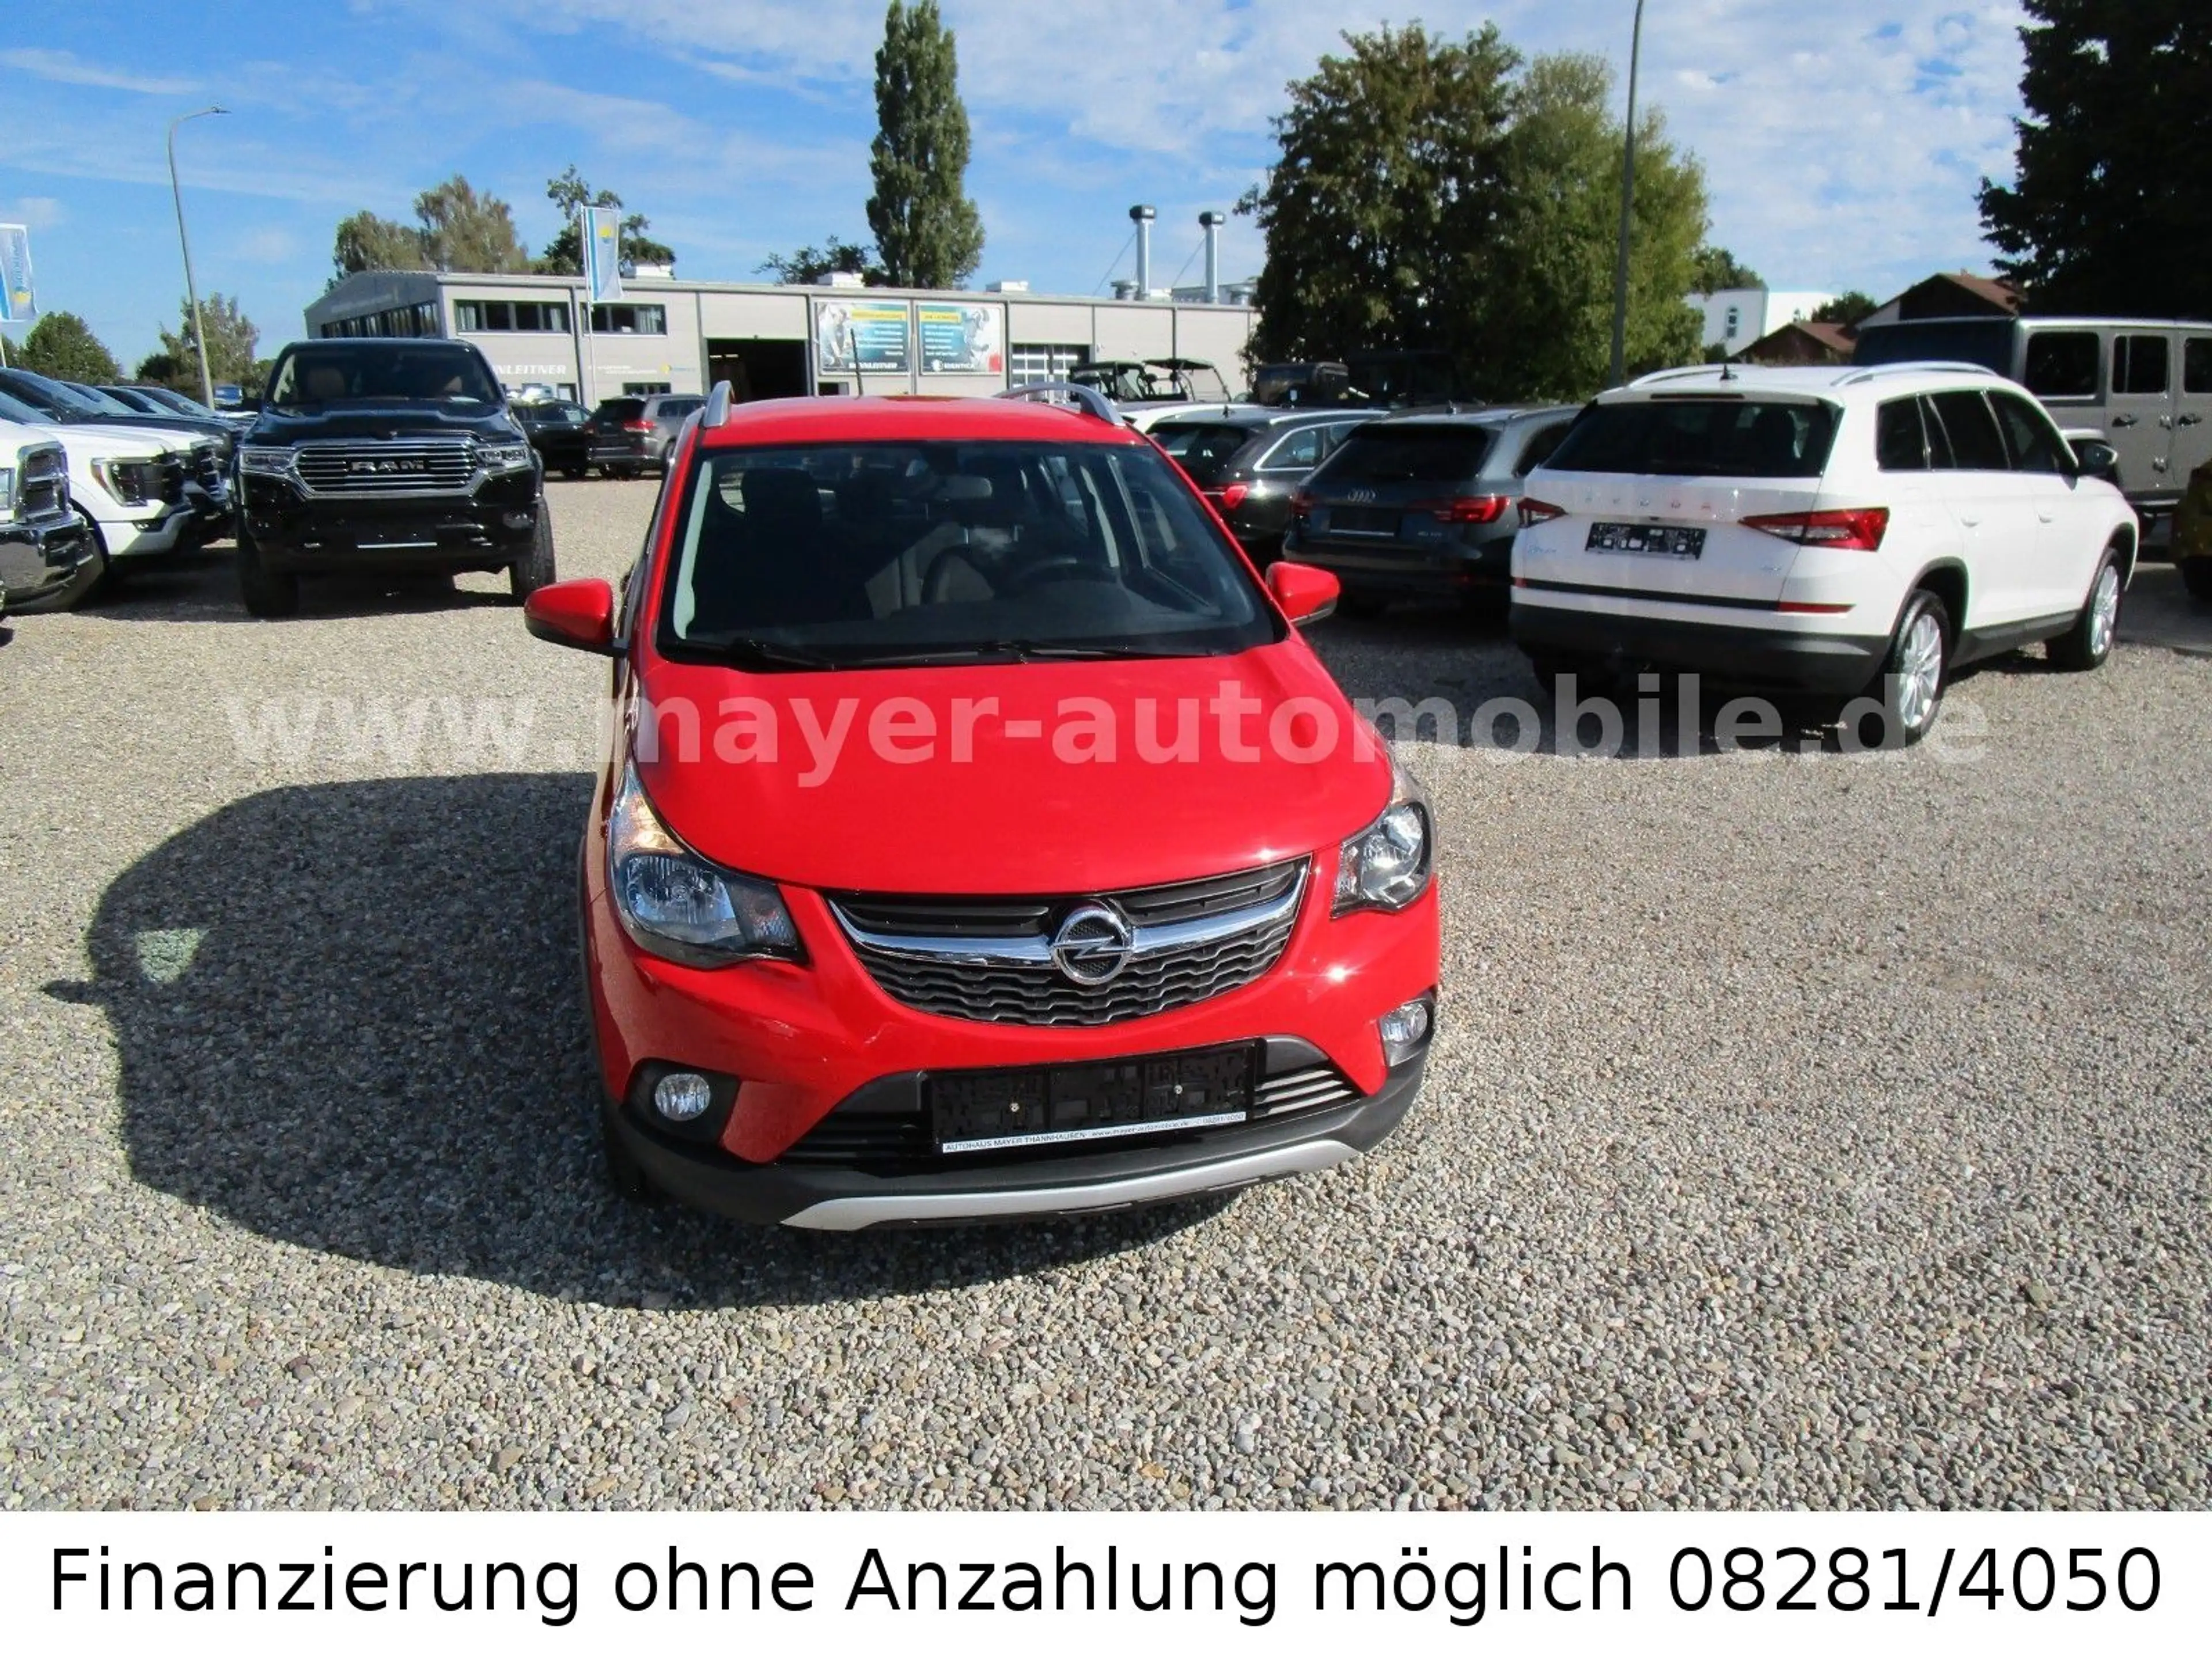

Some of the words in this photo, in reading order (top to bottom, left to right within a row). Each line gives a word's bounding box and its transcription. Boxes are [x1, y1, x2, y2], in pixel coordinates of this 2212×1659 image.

[351, 460, 425, 471] RAM
[946, 1141, 991, 1152] AUTOHAUS
[994, 1138, 1023, 1147] MAYER
[1025, 1132, 1085, 1143] THANNHAUSEN
